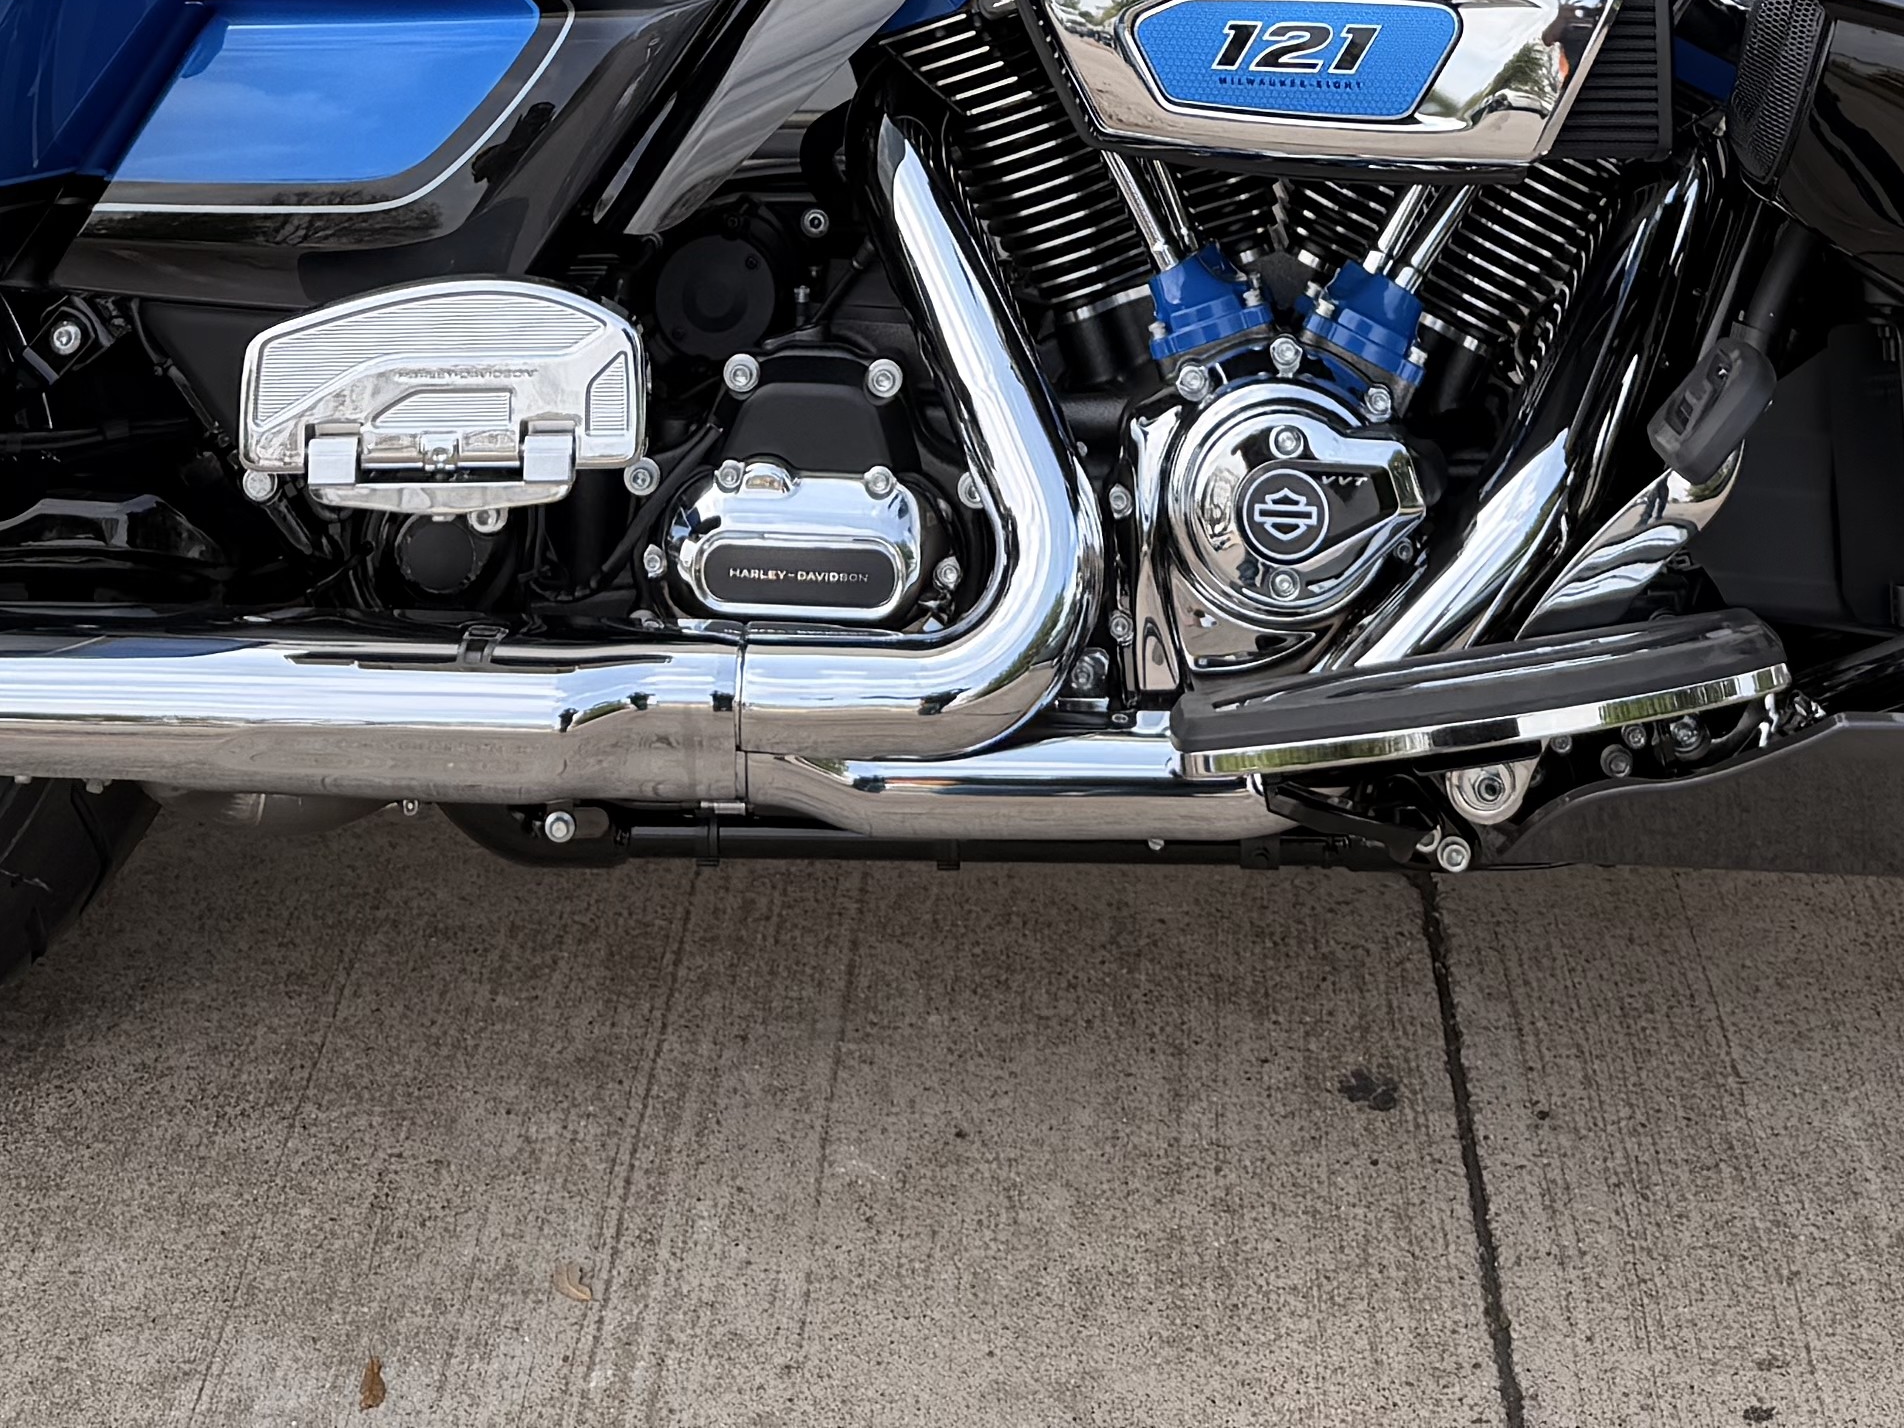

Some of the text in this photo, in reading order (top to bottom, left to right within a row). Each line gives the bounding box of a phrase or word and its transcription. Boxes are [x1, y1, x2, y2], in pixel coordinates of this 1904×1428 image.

[1211, 20, 1383, 75] 121
[1218, 76, 1363, 89] MILWAUKEE-EIGHT
[1321, 474, 1369, 487] VVT
[728, 566, 869, 583] HARLEY-DAVIDSON
